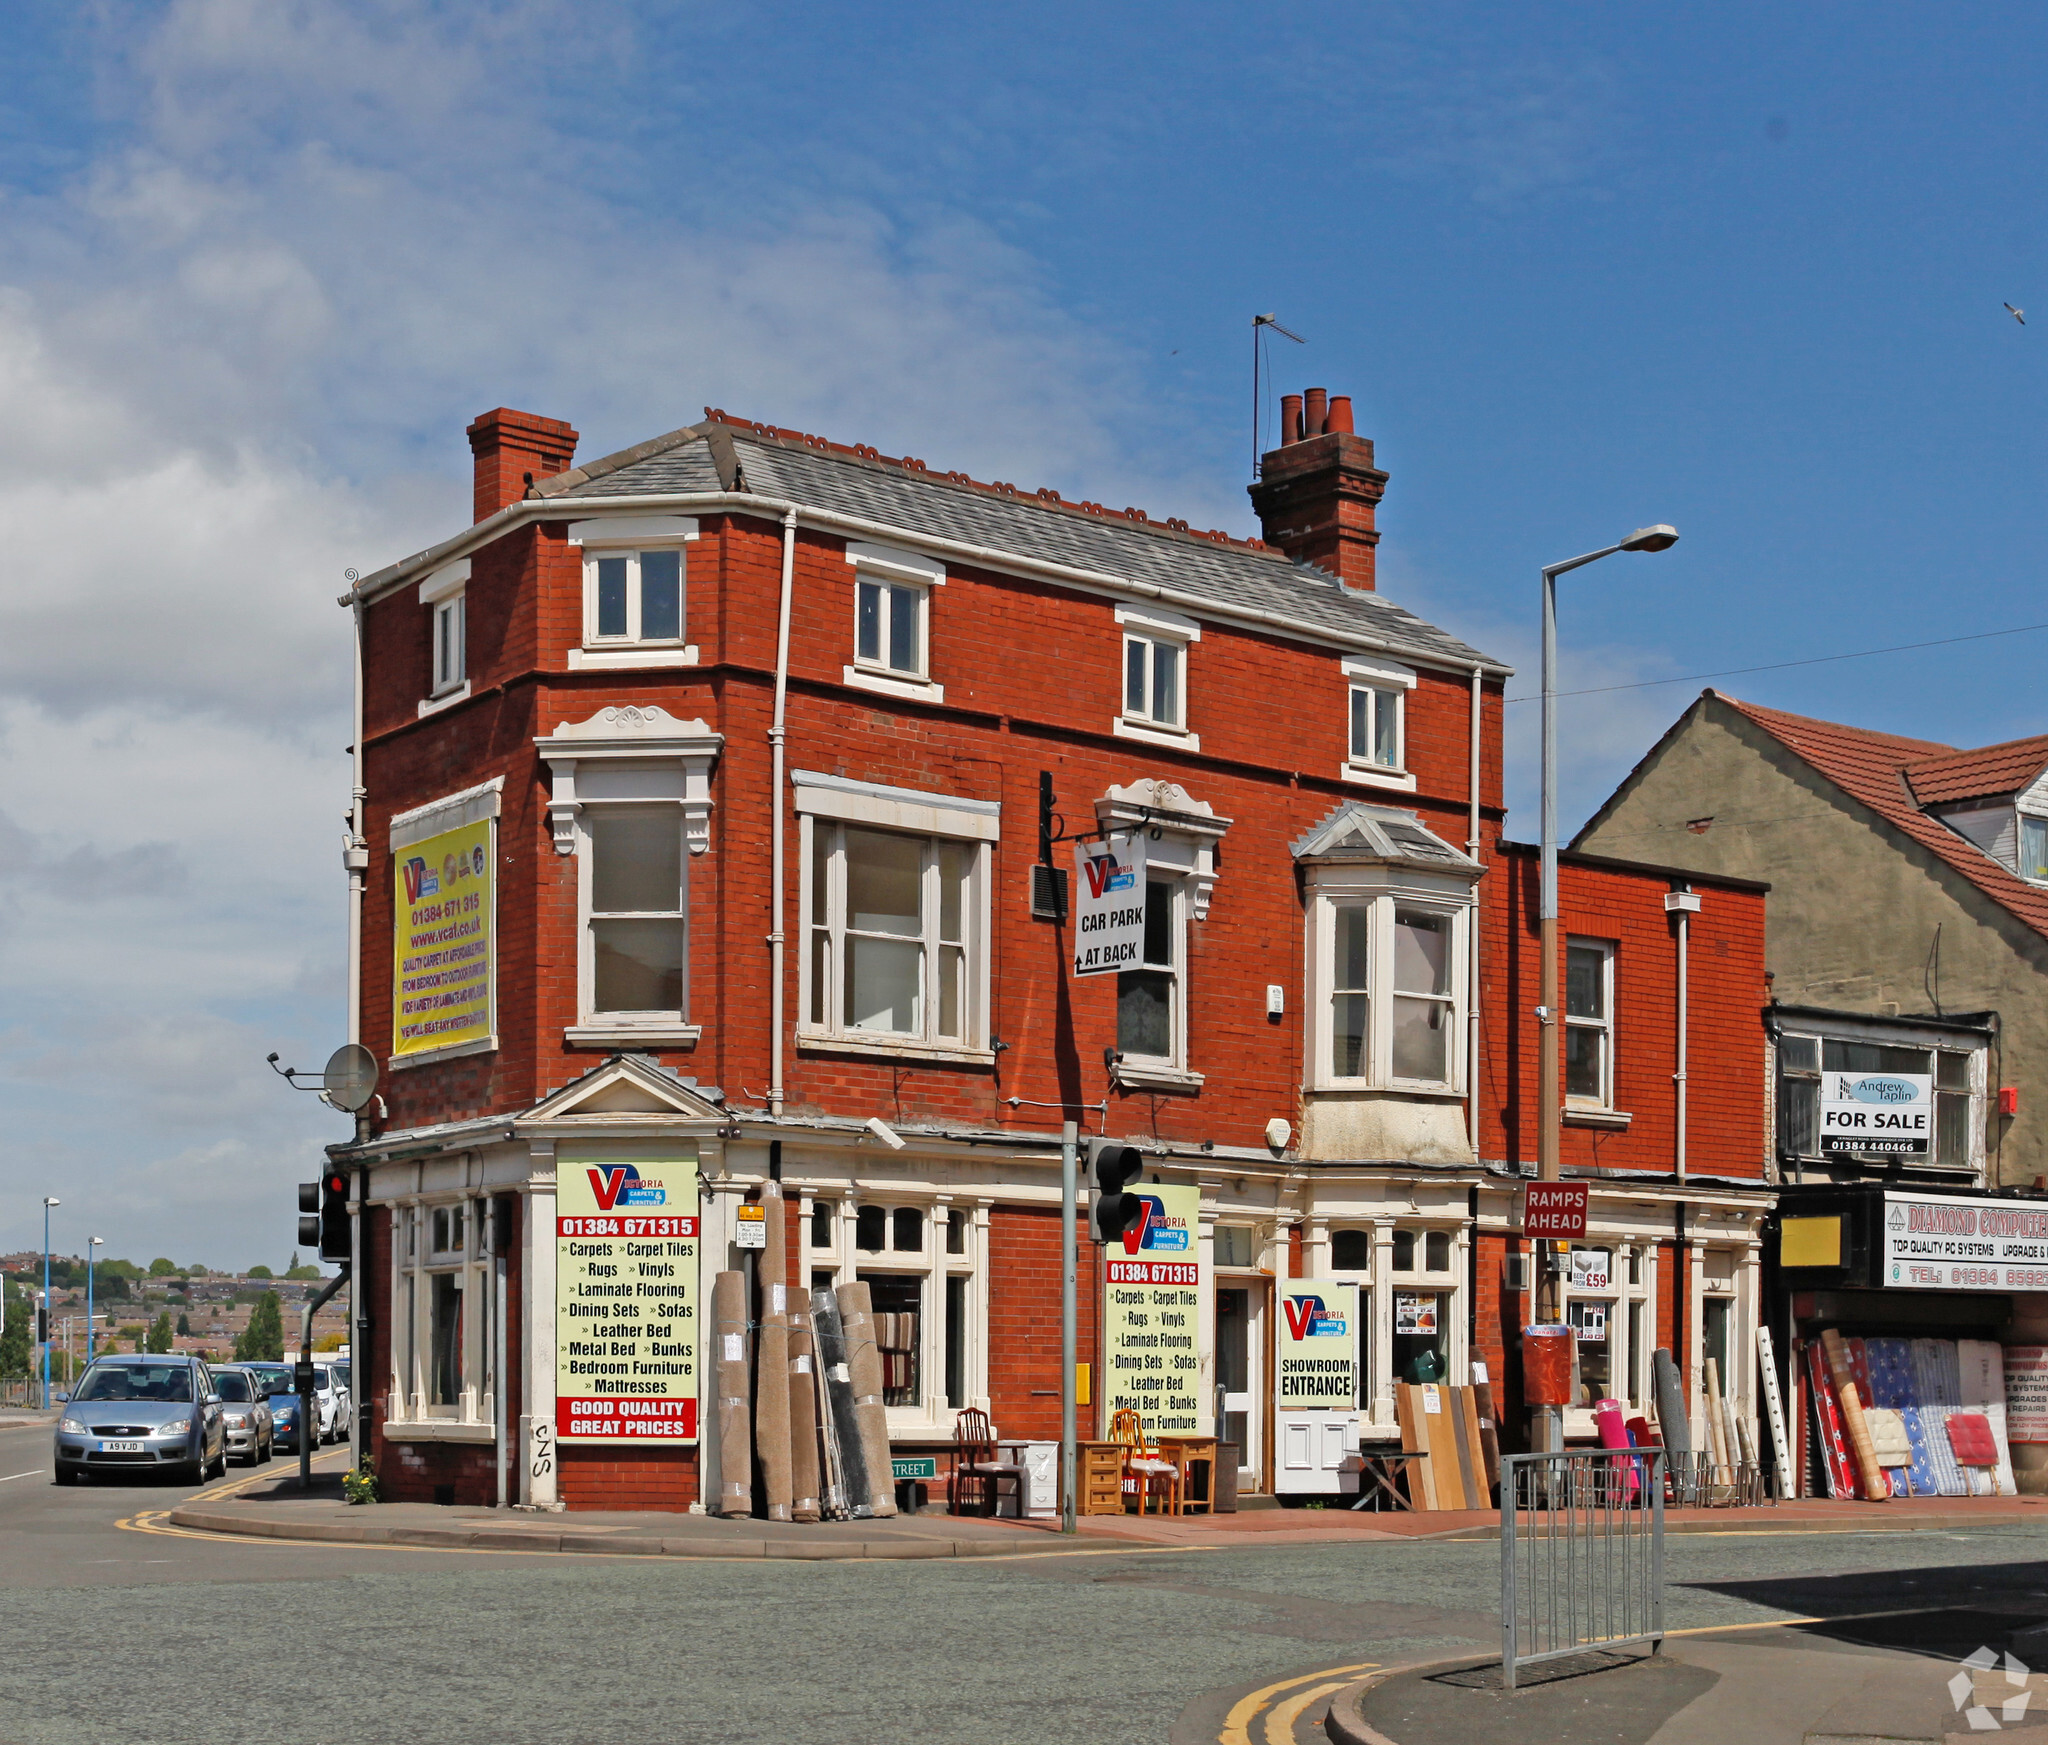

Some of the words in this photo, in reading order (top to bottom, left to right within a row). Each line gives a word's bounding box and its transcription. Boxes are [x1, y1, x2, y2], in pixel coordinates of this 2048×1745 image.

[412, 904, 442, 926] 01384
[444, 898, 461, 917] 671
[464, 893, 479, 912] 315
[1082, 913, 1106, 932] CAR
[1110, 907, 1143, 928] PARK
[411, 915, 481, 948] www.vcaf.co.uk
[1085, 947, 1100, 966] AT
[1104, 942, 1137, 963] BACK
[1858, 1080, 1904, 1093] Andrew
[1826, 1112, 1866, 1127] FOR
[1874, 1113, 1925, 1129] SALE
[1832, 1141, 1866, 1151] 01384
[1869, 1142, 1914, 1152] 440466
[655, 1191, 663, 1200] &
[1529, 1191, 1584, 1208] RAMPS
[562, 1218, 619, 1235] 01384
[624, 1218, 693, 1235] 671315
[1528, 1213, 1582, 1229] AHEAD
[1908, 1205, 1977, 1236] DIAMOND
[1979, 1208, 2048, 1240] COMPUTE
[1155, 1231, 1179, 1239] CARPETS
[1178, 1232, 1186, 1243] &
[570, 1242, 613, 1258] Carpets
[627, 1242, 663, 1258] Carpet
[667, 1242, 693, 1256] Tiles
[1153, 1242, 1184, 1250] FURNITURE
[1892, 1239, 1909, 1253] TOP
[1910, 1241, 1944, 1255] QUALITY
[1945, 1242, 1956, 1255] PC
[1958, 1243, 1994, 1257] SYSTEMS
[2002, 1244, 2038, 1258] UPGRADE
[588, 1262, 618, 1278] Rugs
[638, 1262, 675, 1278] Vinyls
[1110, 1263, 1148, 1282] 01384
[1151, 1264, 1196, 1283] 671315
[1573, 1272, 1586, 1280] BEDS
[1909, 1266, 1942, 1283] TEL:
[1951, 1268, 1998, 1285] 01384
[1070, 1275, 1075, 1283] 3
[1573, 1279, 1586, 1287] FROM
[1586, 1273, 1607, 1288] £59
[578, 1282, 633, 1297] Laminate
[636, 1282, 685, 1299] Flooring
[1115, 1289, 1144, 1306] Carpets
[1153, 1290, 1178, 1306] Carpet
[1179, 1290, 1197, 1306] Tiles
[569, 1303, 609, 1319] Dining
[612, 1303, 640, 1317] Sets
[658, 1303, 693, 1318] Sofas
[1128, 1311, 1148, 1328] Rugs
[1161, 1312, 1185, 1328] Vinyls
[593, 1323, 643, 1338] Leather
[647, 1324, 672, 1338] Bed
[1121, 1332, 1158, 1348] Laminate
[1160, 1333, 1192, 1350] Flooring
[569, 1342, 606, 1356] Metal
[611, 1342, 636, 1356] Bed
[652, 1342, 692, 1357] Bunks
[570, 1360, 628, 1375] Bedroom
[633, 1361, 692, 1375] Furniture
[1115, 1354, 1142, 1371] Dining
[1145, 1354, 1163, 1369] Sets
[1174, 1355, 1197, 1369] Sofas
[1282, 1359, 1350, 1373] SHOWROOM
[595, 1379, 667, 1393] Mattresses
[1131, 1376, 1164, 1391] Leather
[1167, 1376, 1183, 1391] Bed
[1282, 1376, 1351, 1396] ENTRANCE
[571, 1401, 614, 1415] GOOD
[619, 1401, 684, 1417] QUALITY
[1115, 1395, 1140, 1410] Metal
[1143, 1395, 1160, 1410] Bed
[1170, 1395, 1197, 1410] Bunks
[2013, 1405, 2046, 1413] REPAIRS
[570, 1420, 621, 1435] GREAT
[625, 1421, 684, 1435] PRICES
[1158, 1415, 1197, 1430] Furniture
[110, 1443, 120, 1451] A9
[122, 1443, 138, 1451] VJD
[892, 1464, 926, 1475] TREET
